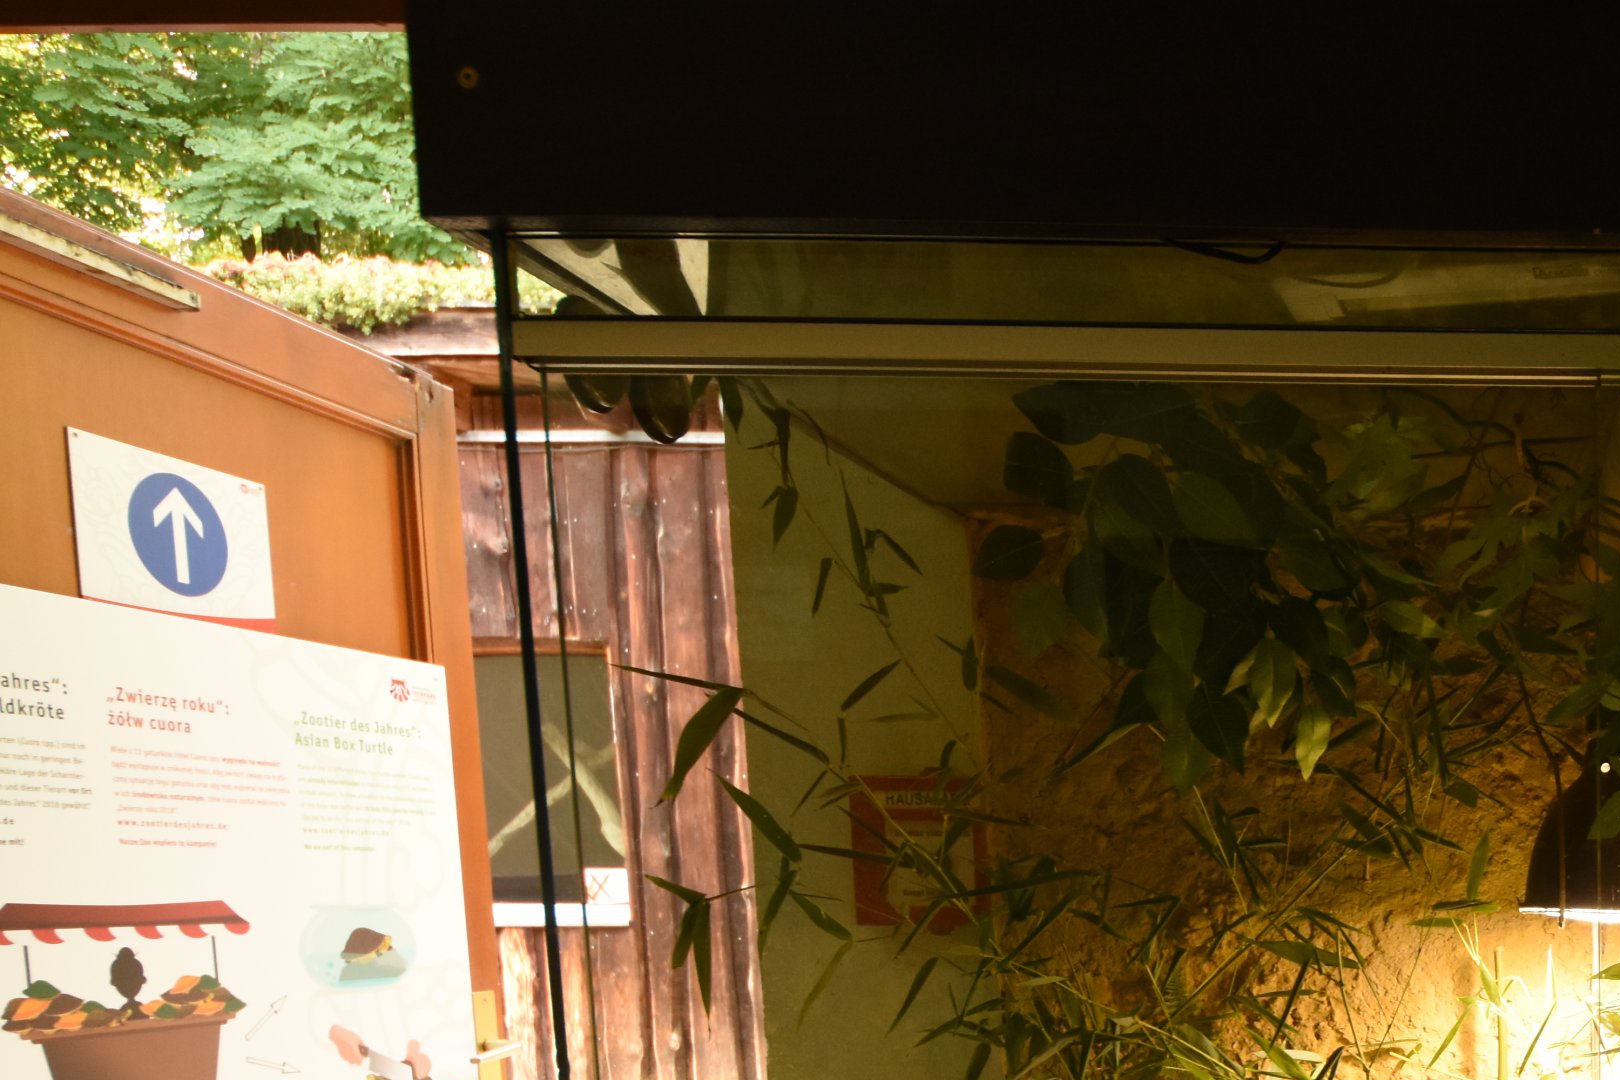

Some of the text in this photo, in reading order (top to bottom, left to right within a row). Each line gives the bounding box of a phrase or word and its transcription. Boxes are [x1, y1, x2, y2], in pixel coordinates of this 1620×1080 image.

[106, 686, 230, 716] „Zwierzę roku“:
[107, 709, 192, 733] żółw cuora
[293, 711, 422, 740] „Zootier des Jahres“:
[294, 732, 393, 756] Asian Box Turtle
